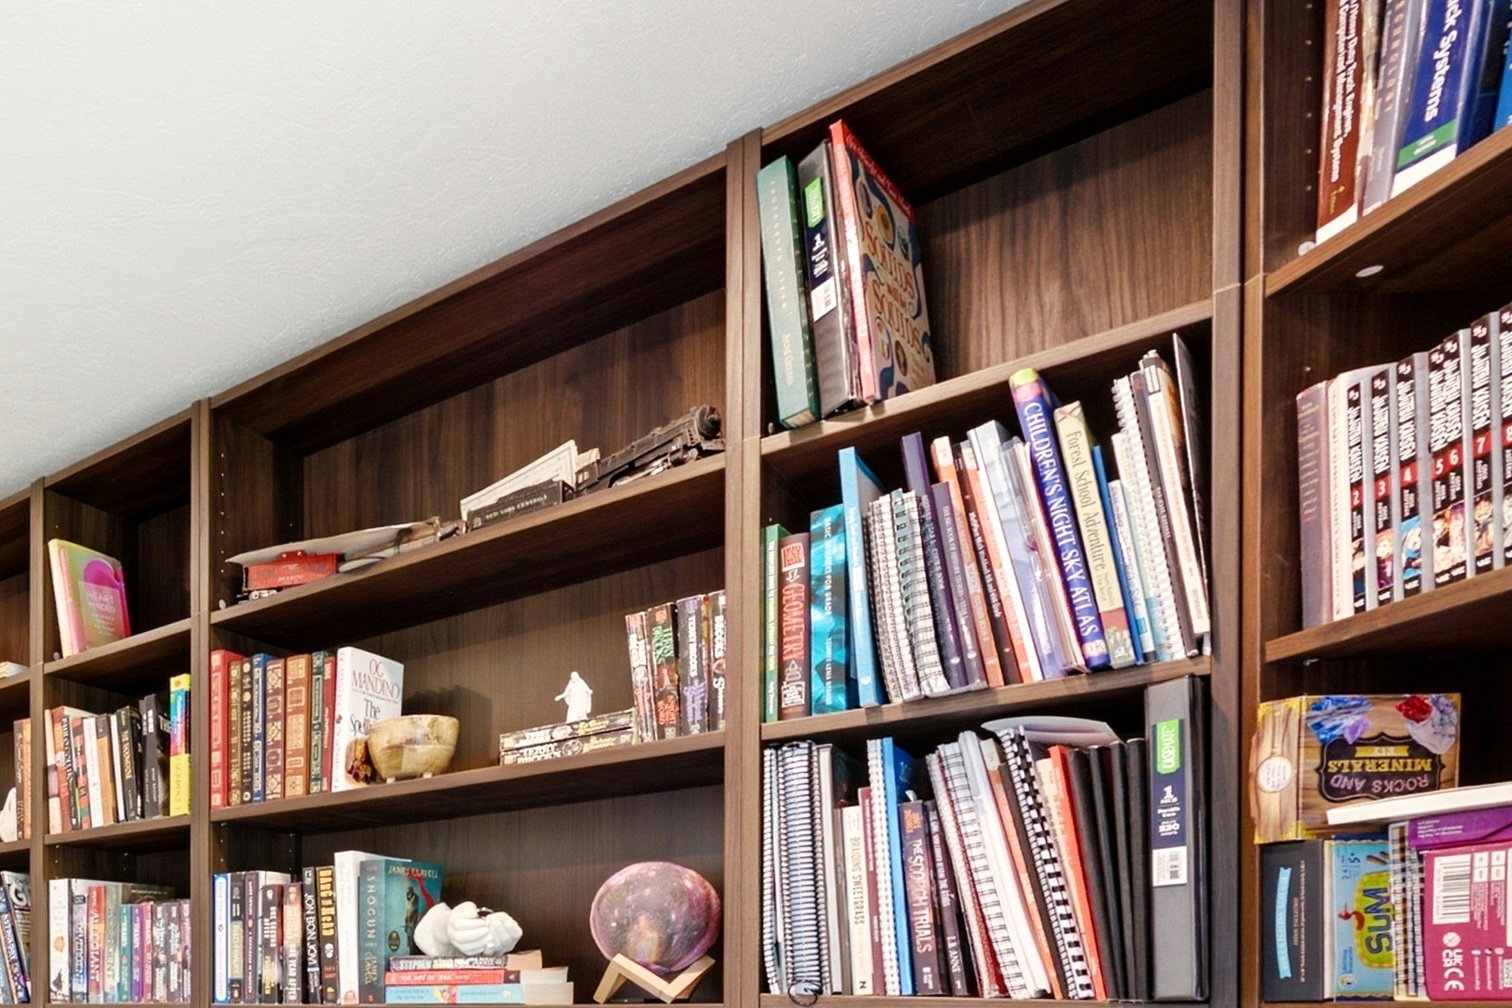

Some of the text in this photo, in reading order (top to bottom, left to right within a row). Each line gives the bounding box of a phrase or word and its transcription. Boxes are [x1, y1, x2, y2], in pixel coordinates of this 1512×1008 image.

[1425, 30, 1458, 123] Systems
[1397, 379, 1414, 482] JUJUTSU KAISEN 4
[1430, 412, 1446, 453] KAISEN
[1446, 400, 1462, 440] KAISEN
[1471, 343, 1491, 454] JUJUTSU KAISEN 7
[1348, 405, 1363, 505] JUJUTSU KAISEN 2
[1372, 395, 1389, 495] JUJUTSU KAISEN 3
[1434, 460, 1444, 475] 5
[1450, 450, 1459, 465] 6
[1023, 401, 1100, 637] CHILDREN'S NIGHT SKY ATLAS
[1065, 430, 1108, 571] Forest School Adventure
[781, 582, 806, 661] GEOMETRY
[1328, 758, 1433, 774] MINERALS
[1330, 773, 1429, 793] ROCKS AND
[849, 836, 865, 926] BRAIDING SWEETGRASS
[908, 855, 928, 907] SCORCH
[90, 910, 101, 982] ALLEGIANT
[912, 908, 934, 954] TRIALS
